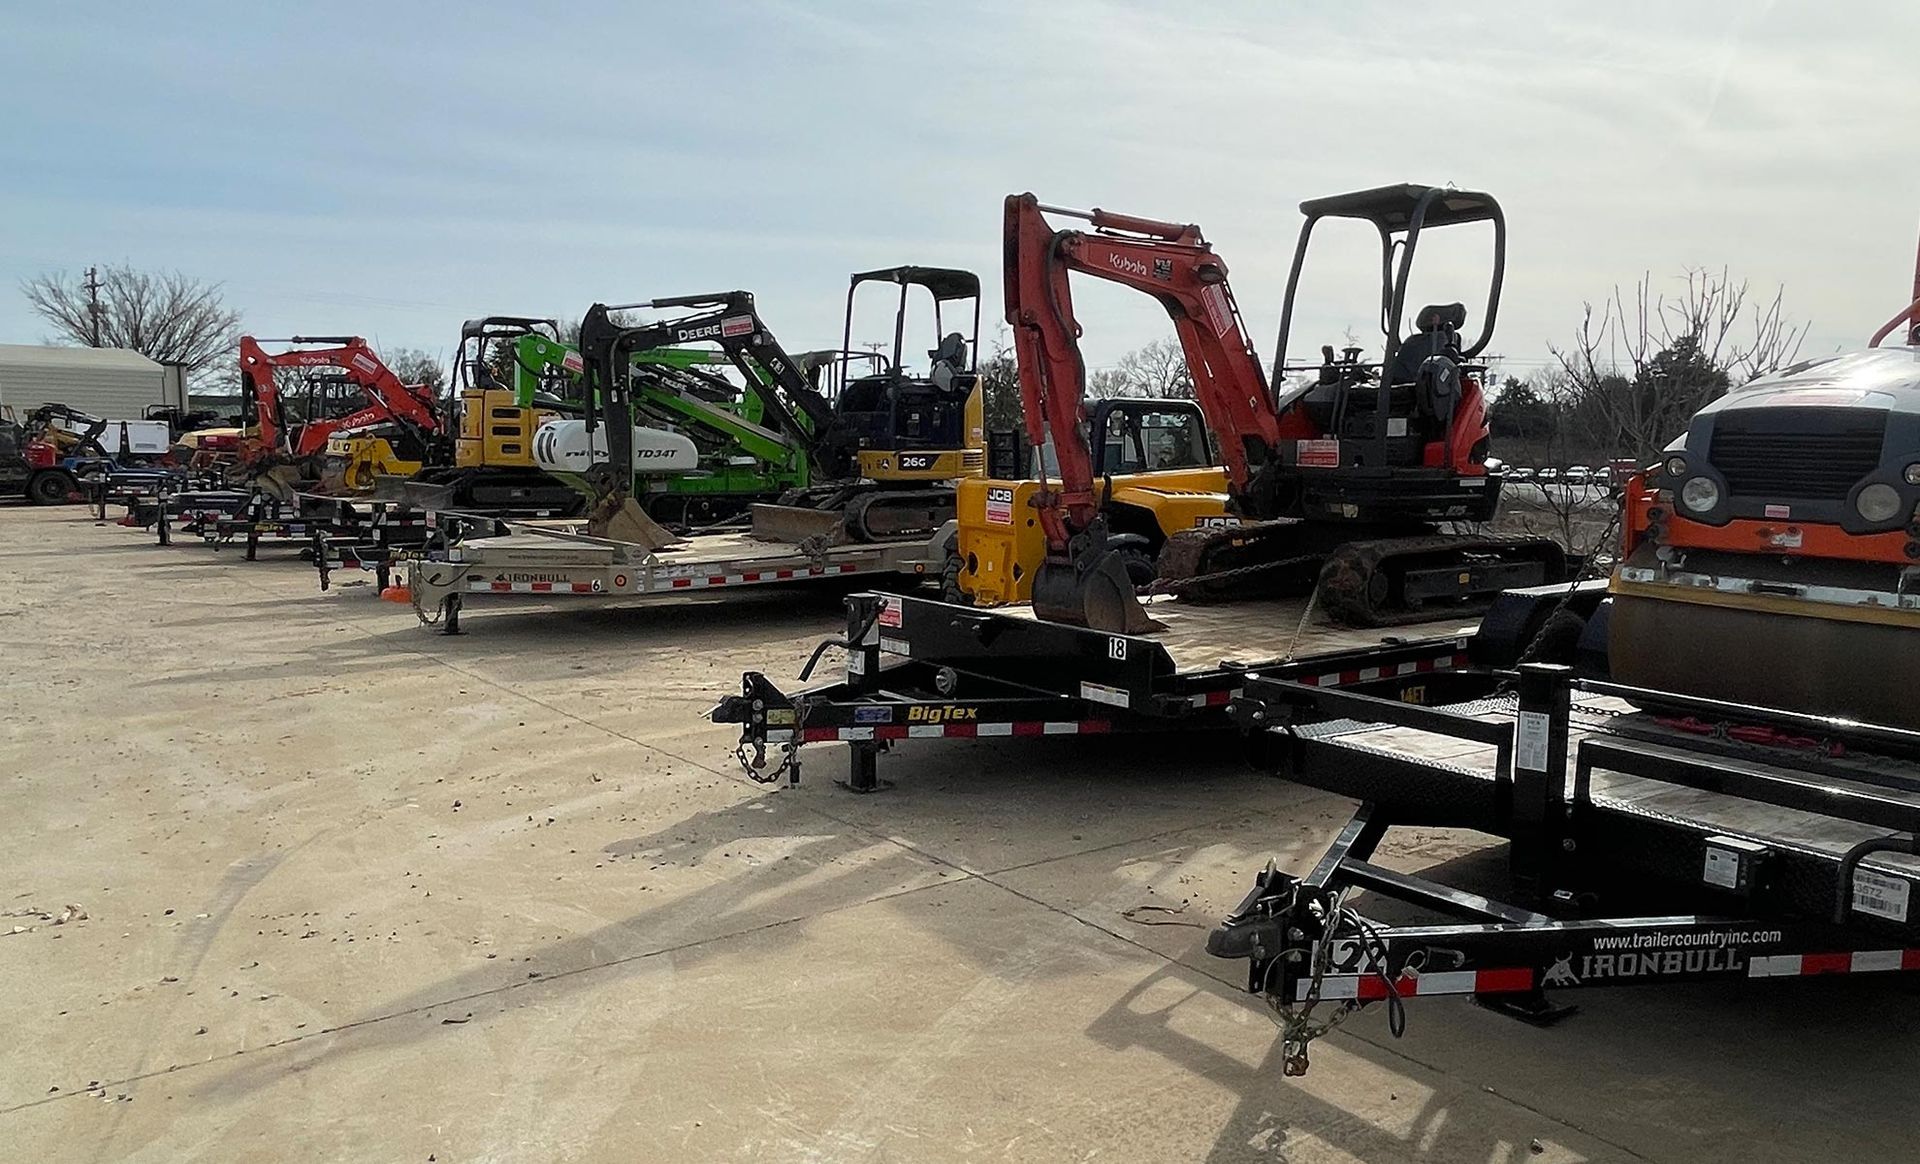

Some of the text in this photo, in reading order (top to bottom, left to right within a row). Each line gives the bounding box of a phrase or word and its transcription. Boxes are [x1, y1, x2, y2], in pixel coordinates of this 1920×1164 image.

[1109, 252, 1147, 276] Kubota
[678, 325, 721, 341] DEERE
[637, 449, 678, 458] TD34T
[903, 457, 926, 467] 26G
[989, 489, 1012, 502] JCB
[508, 573, 570, 583] IRONBULL
[1110, 638, 1125, 658] 18
[908, 705, 978, 723] BigTex
[1853, 883, 1883, 897] 3572
[1594, 929, 1782, 949] www.trailercountryinc.com
[1581, 948, 1743, 979] IRONBULL
